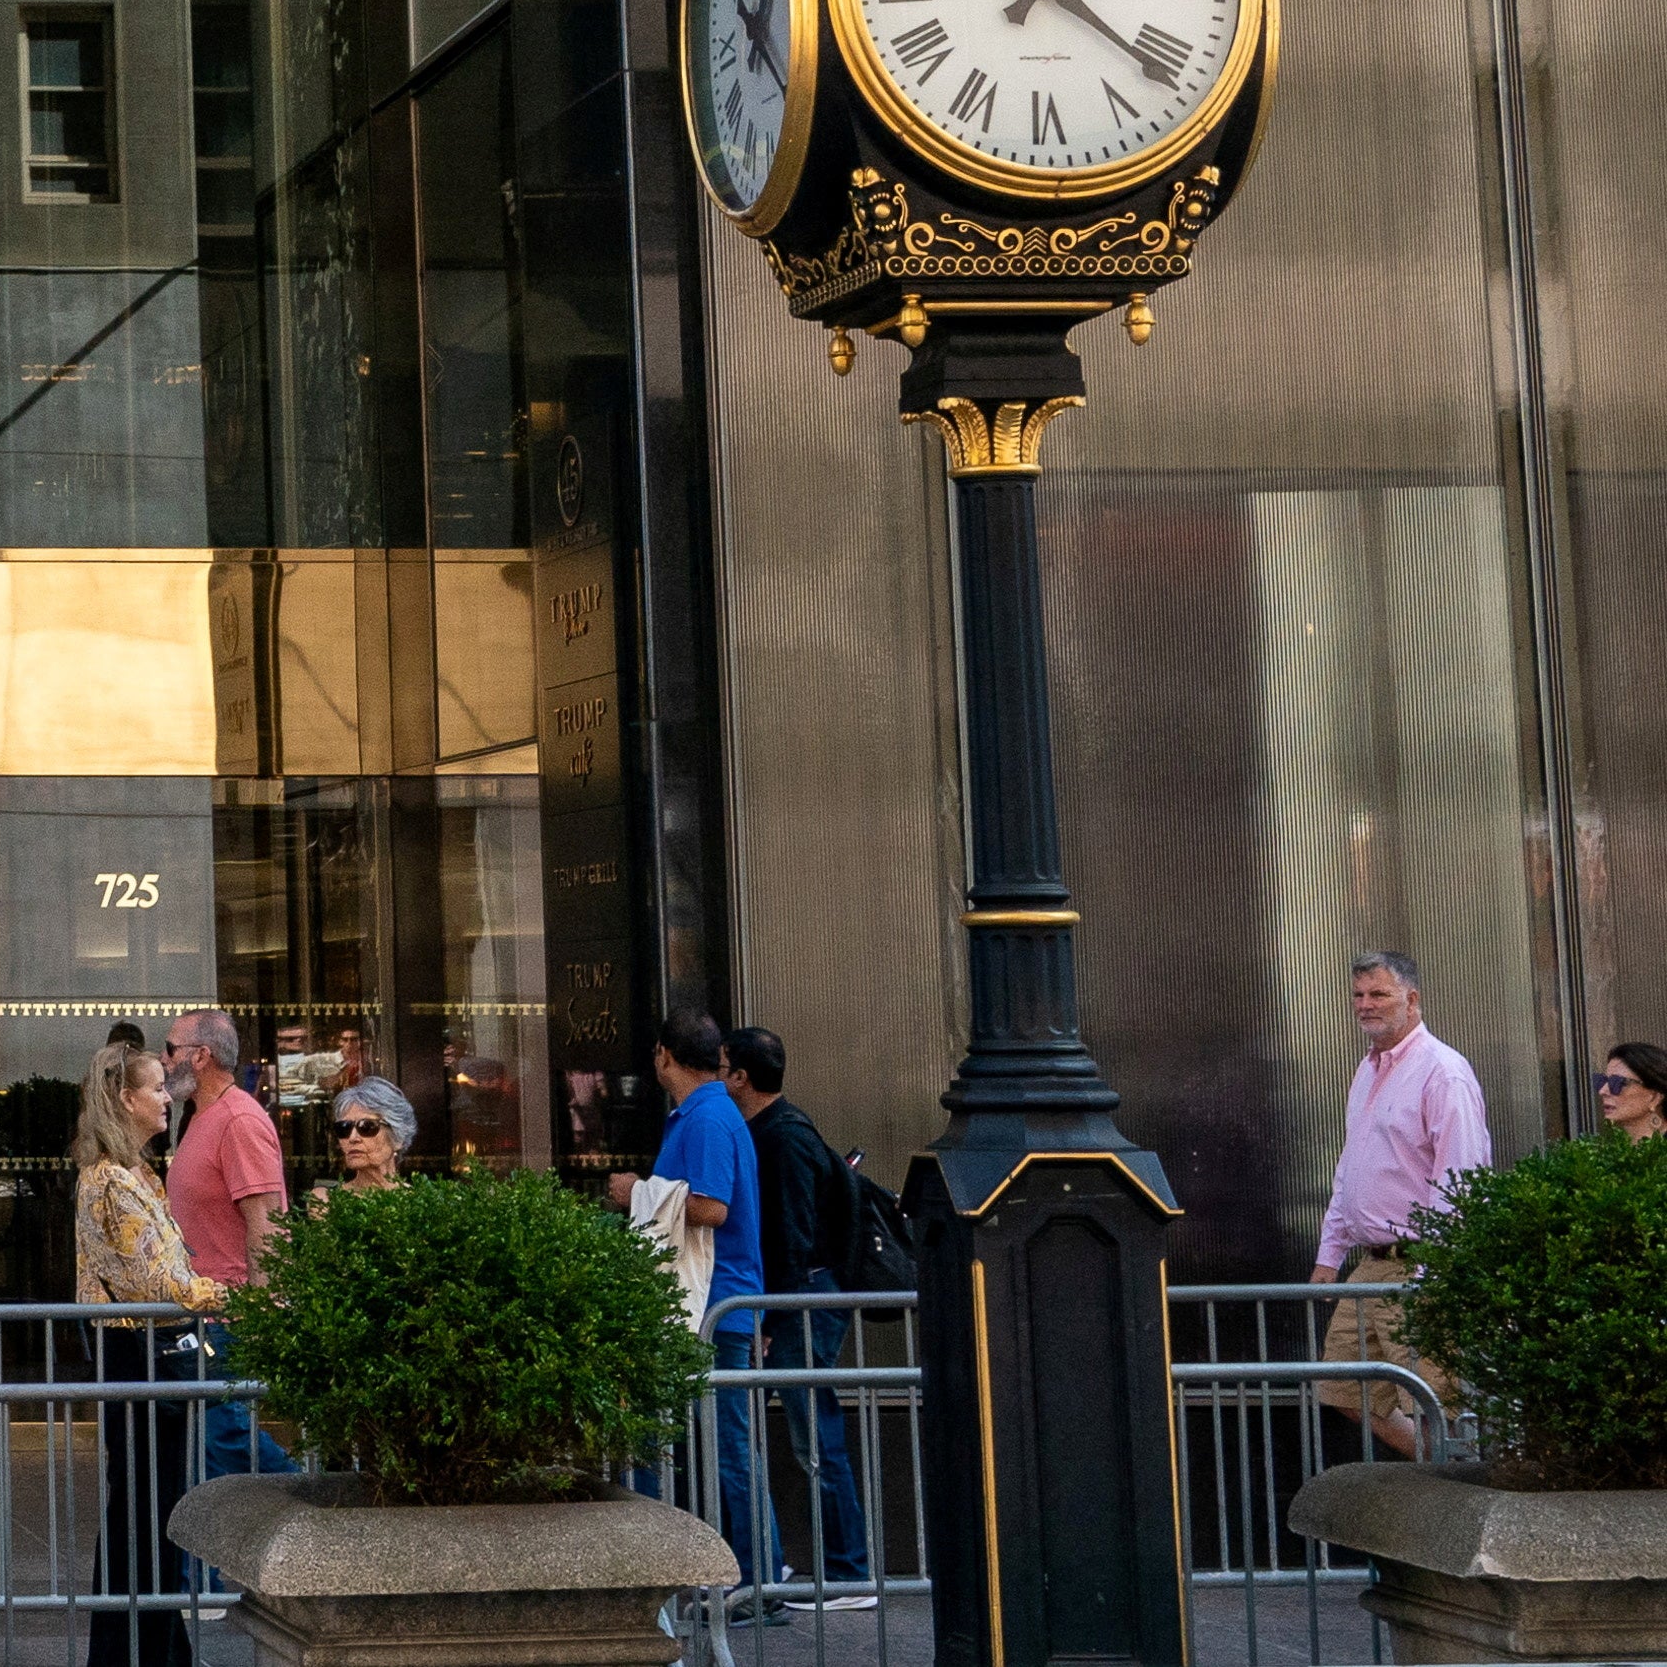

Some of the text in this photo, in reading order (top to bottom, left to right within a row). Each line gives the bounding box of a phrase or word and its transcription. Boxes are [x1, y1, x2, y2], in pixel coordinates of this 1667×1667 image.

[549, 583, 601, 624] TRUMP
[554, 698, 607, 736] TRUMP
[94, 872, 161, 909] 725
[553, 866, 587, 888] TRUMP
[566, 962, 611, 988] TRUMP
